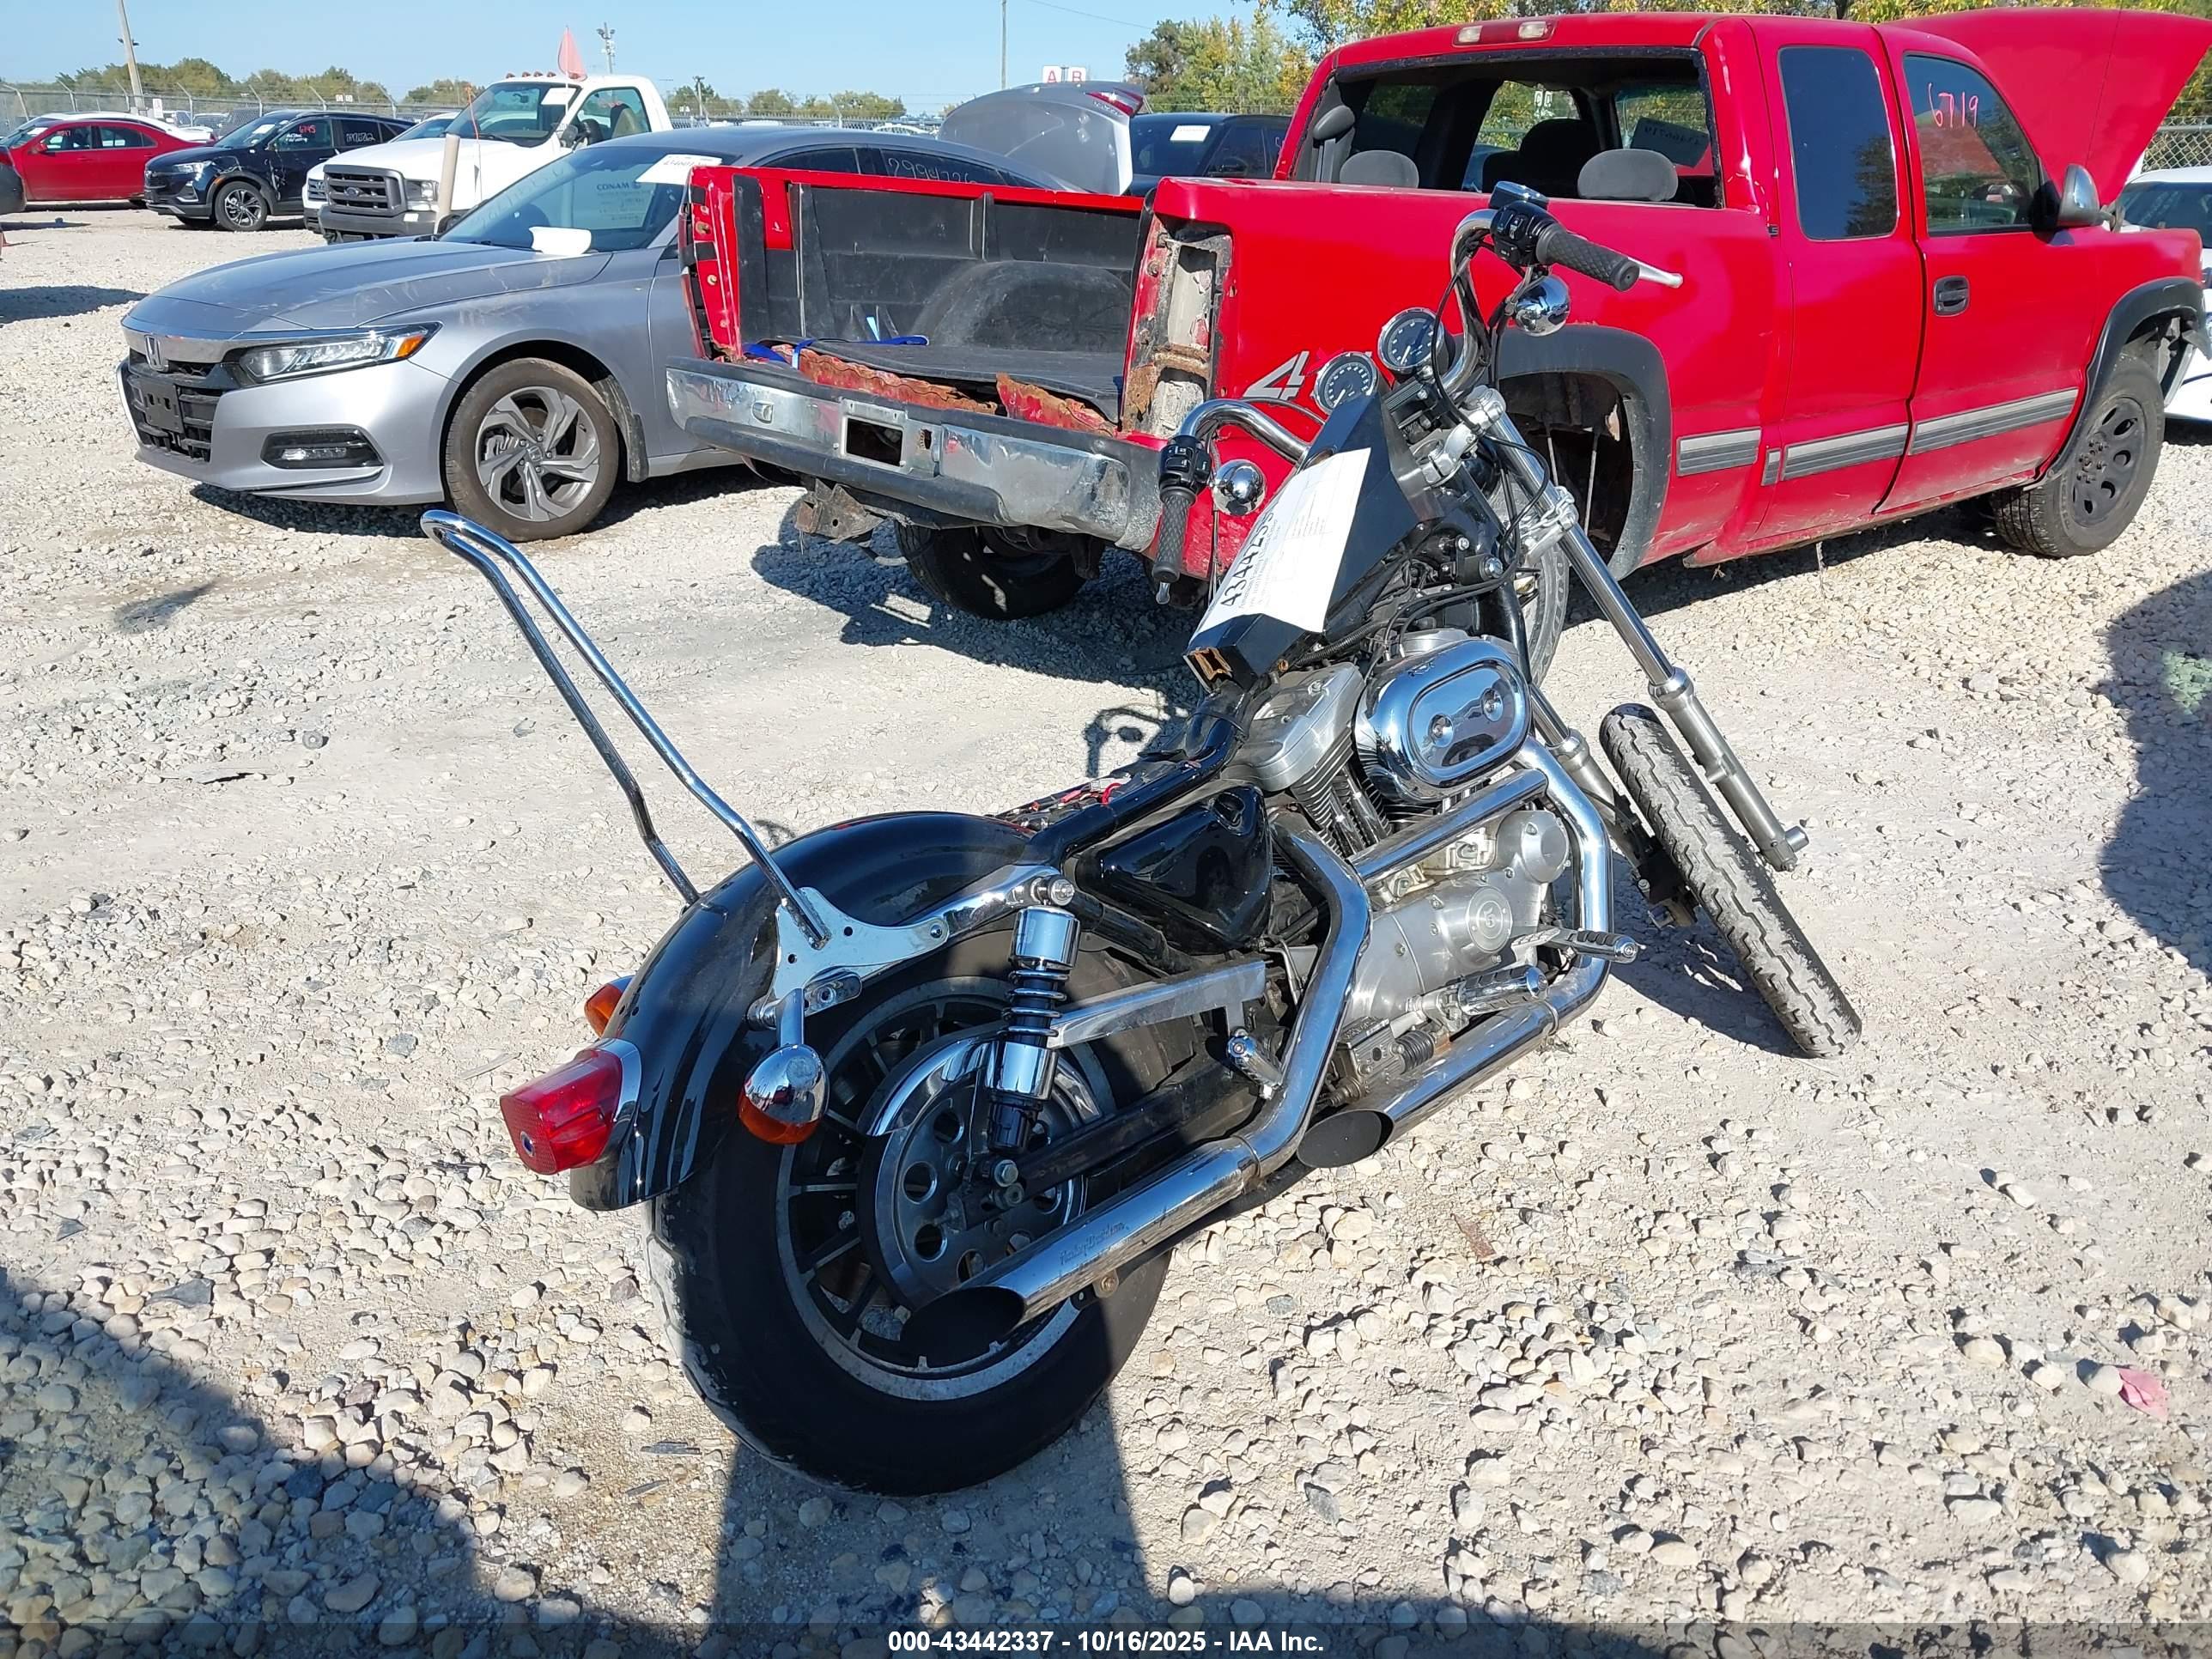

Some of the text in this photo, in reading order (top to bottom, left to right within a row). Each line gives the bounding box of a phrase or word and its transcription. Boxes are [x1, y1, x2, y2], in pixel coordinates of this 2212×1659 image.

[1047, 70, 1057, 82] A
[1072, 70, 1082, 82] B
[1929, 82, 1978, 128] 6719
[596, 181, 629, 191] CONAM
